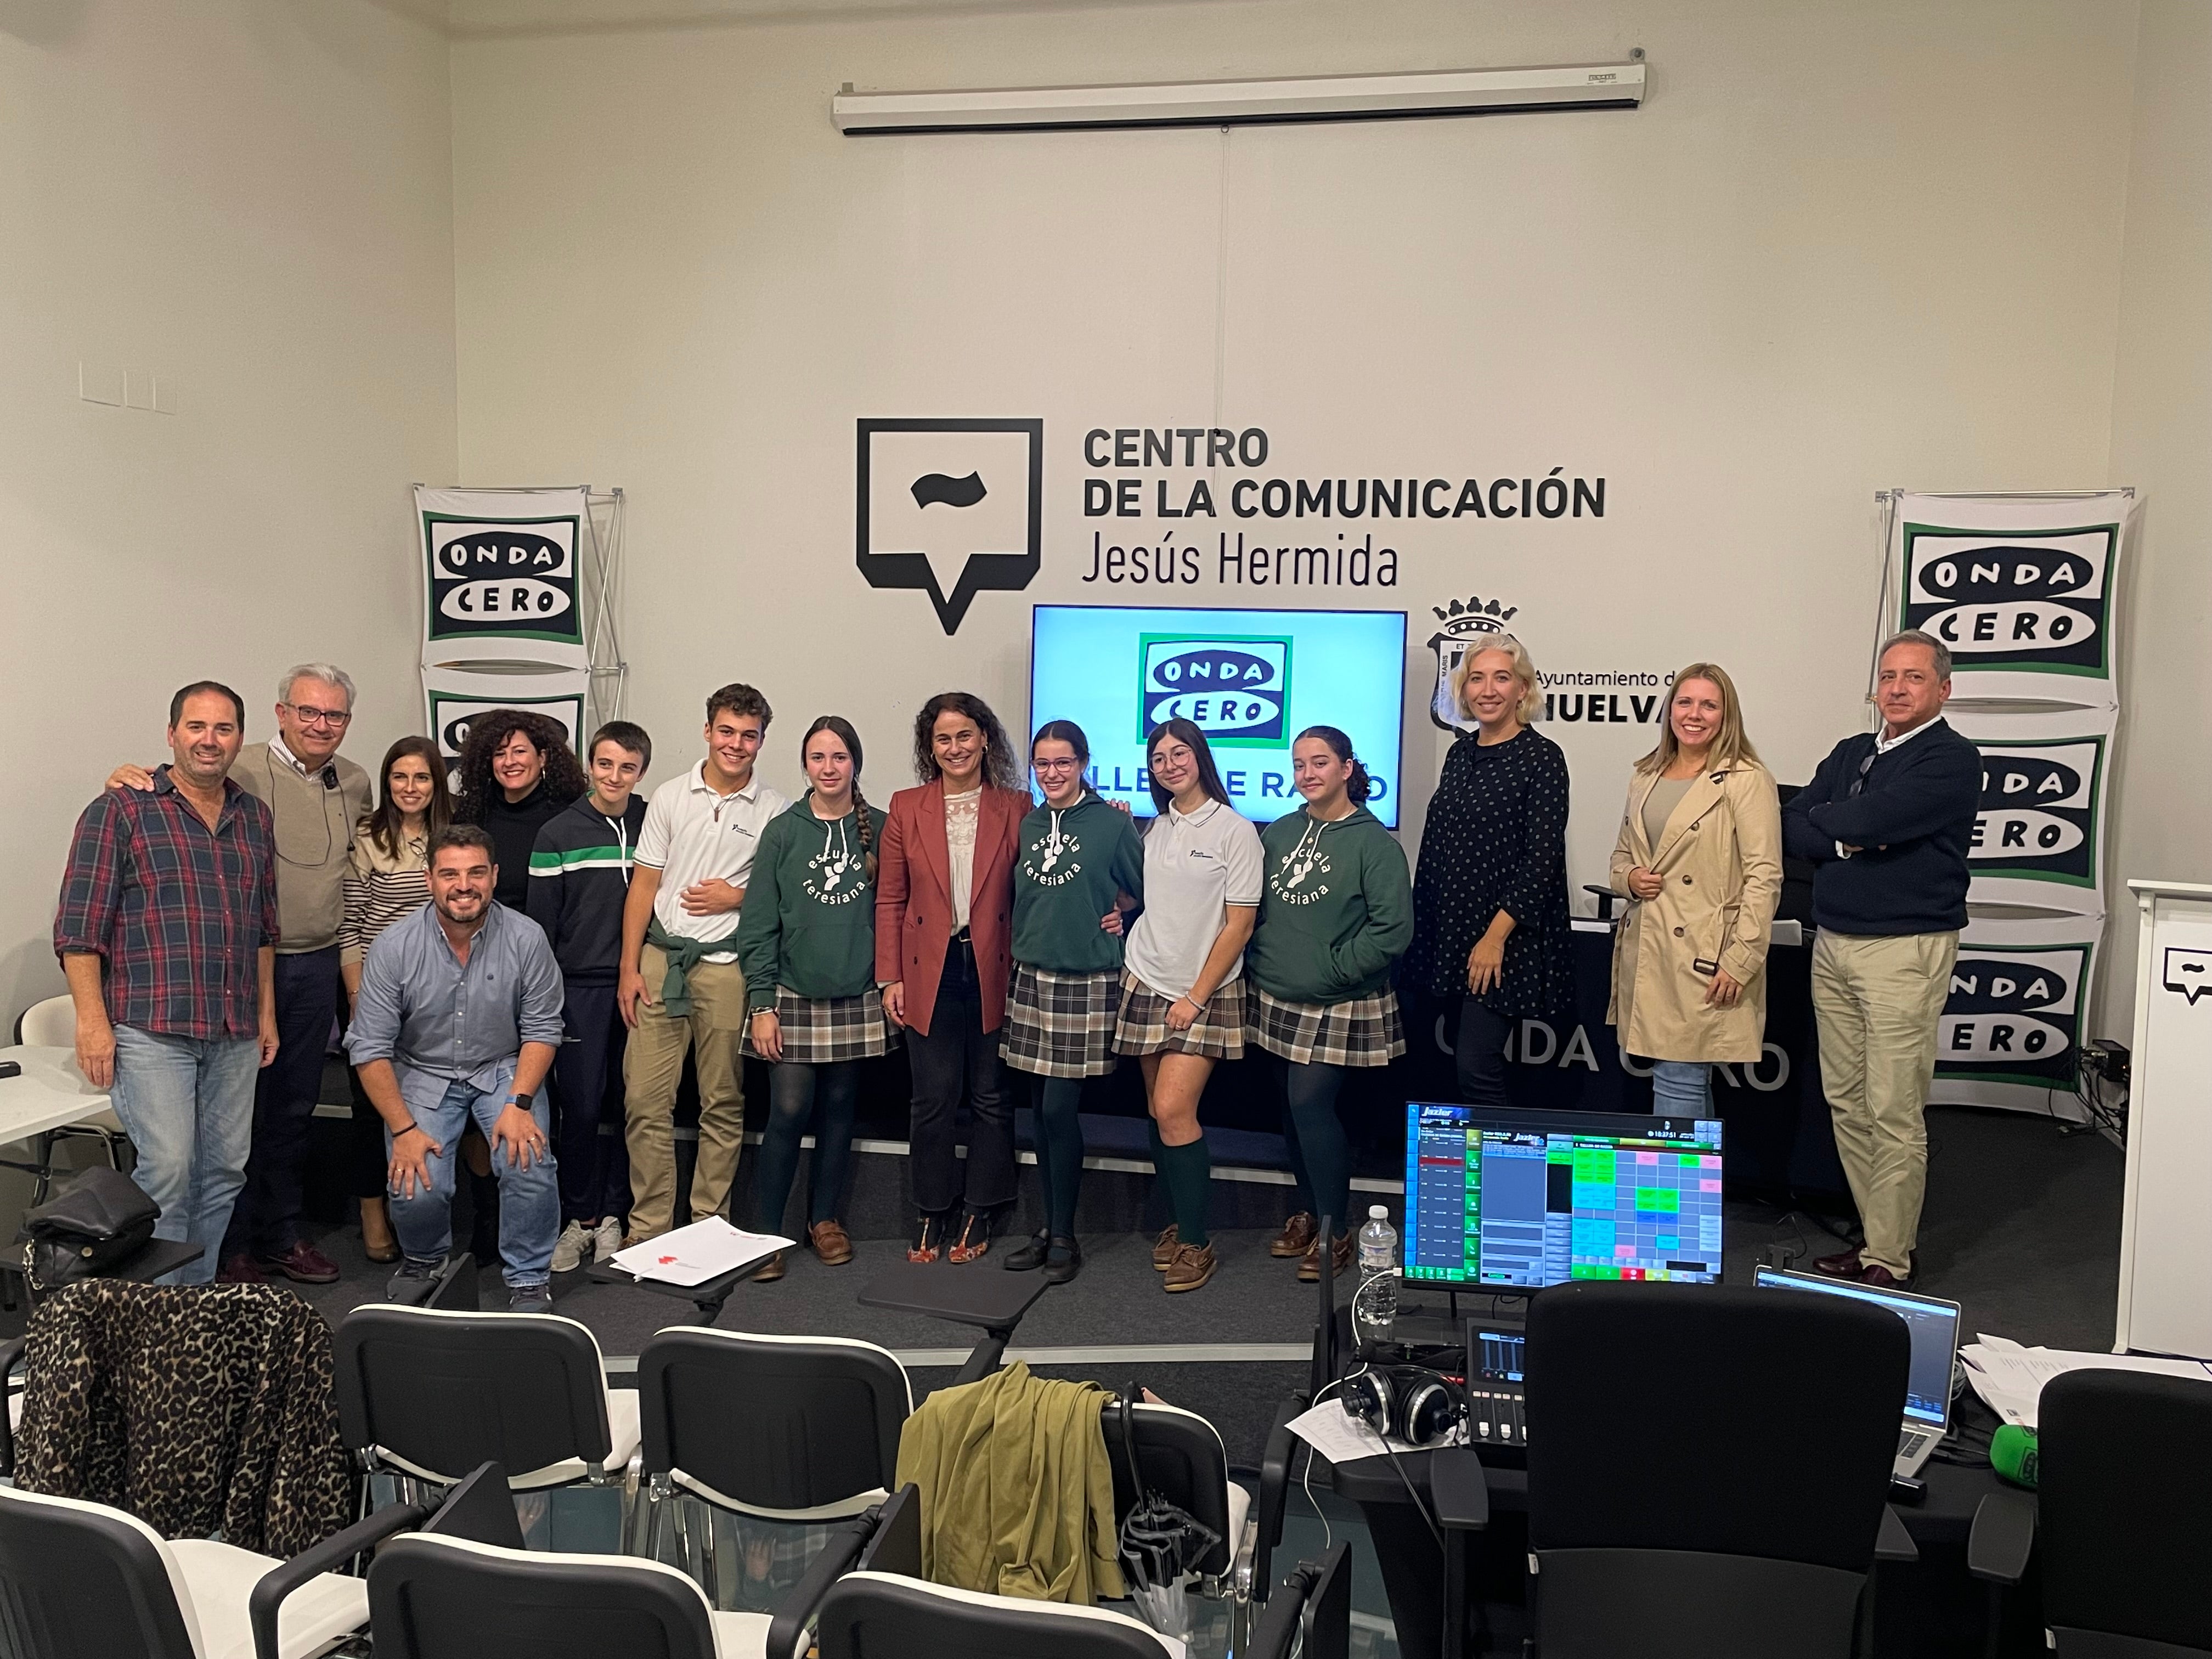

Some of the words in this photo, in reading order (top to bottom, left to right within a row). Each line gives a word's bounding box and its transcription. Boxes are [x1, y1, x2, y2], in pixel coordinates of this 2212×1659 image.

[1084, 428, 1268, 467] CENTRO
[1084, 479, 1141, 517] DE
[1158, 479, 1217, 517] LA
[1232, 467, 1606, 518] COMUNICACIÓN
[450, 544, 553, 567] ONDA
[1082, 531, 1200, 584] Jesús
[1219, 532, 1398, 586] Hermida
[1934, 561, 2075, 588] ONDA
[458, 587, 554, 613] CERO
[1939, 612, 2073, 642] CERO
[1164, 661, 1263, 682] ONDA
[1536, 670, 1658, 689] Ayuntamiento
[1664, 670, 1675, 686] d
[1170, 699, 1262, 721] CERO
[1545, 693, 1666, 723] UELV
[1092, 765, 1150, 792] LLE
[1227, 771, 1246, 796] E
[1982, 771, 2063, 794] DA
[1031, 833, 1080, 853] escela
[1971, 820, 2061, 849] ERO
[808, 850, 862, 871] esula
[1024, 860, 1081, 886] teresiana
[1282, 848, 1331, 873] ecuela
[803, 879, 866, 905] teresiana
[1270, 873, 1329, 905] teresiana
[1949, 975, 2050, 1000] NDA
[1952, 1023, 2047, 1053] ERO
